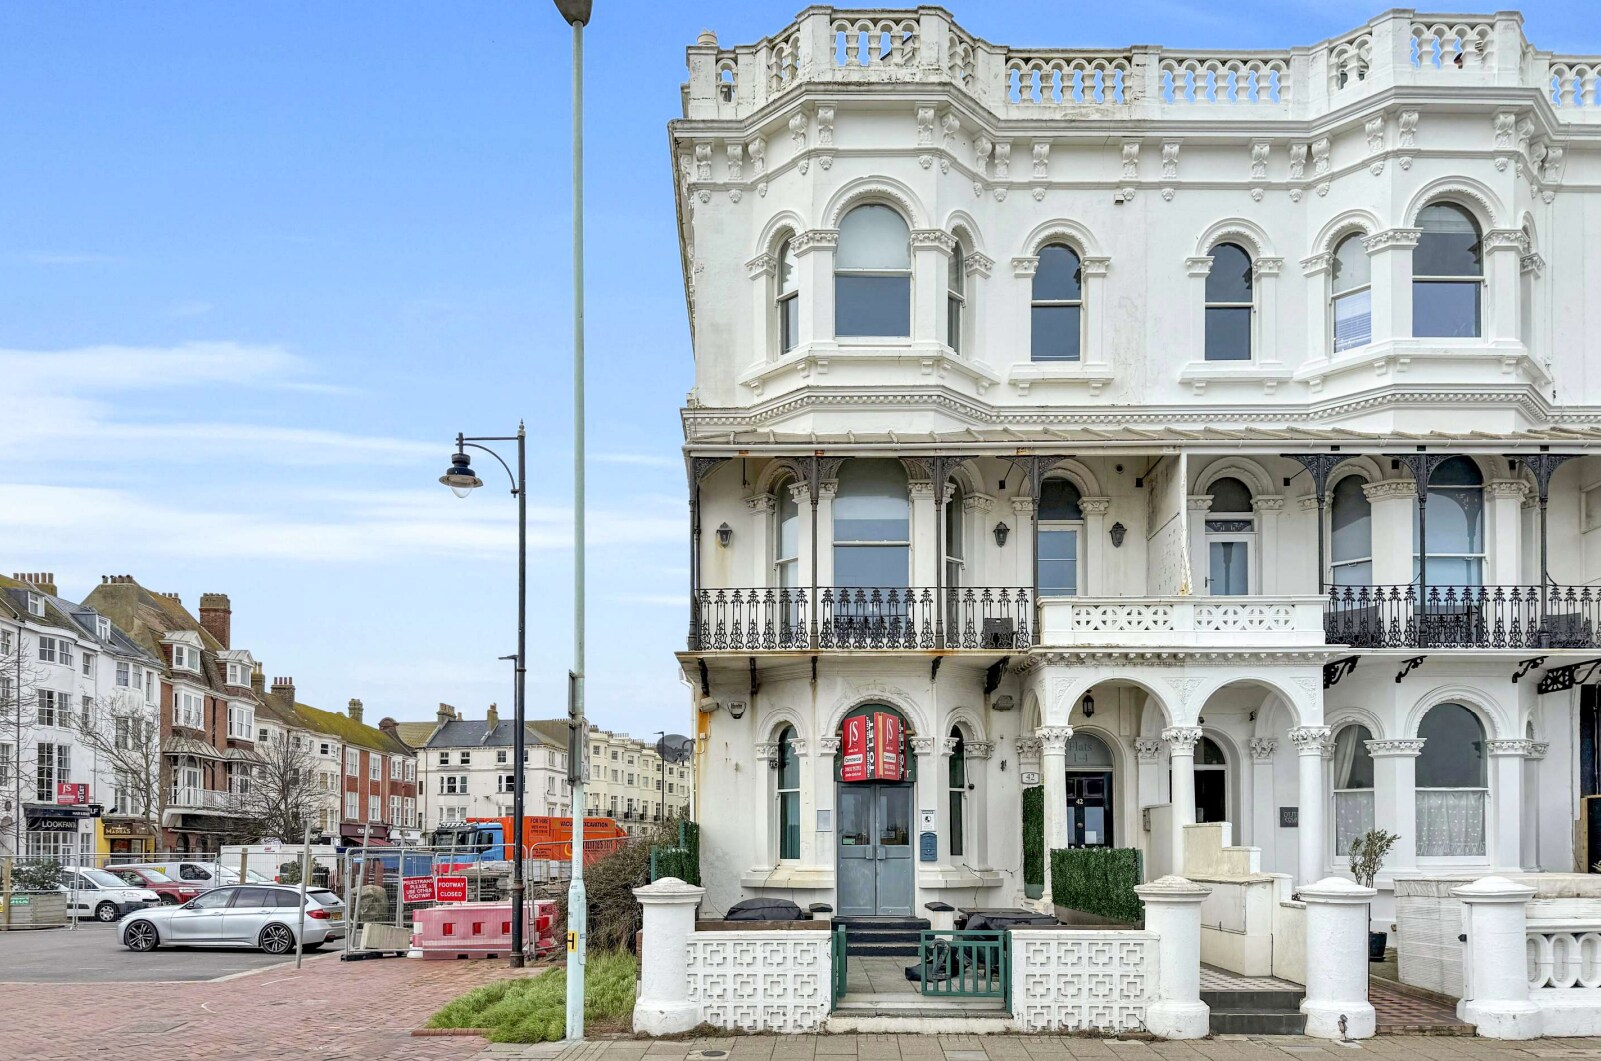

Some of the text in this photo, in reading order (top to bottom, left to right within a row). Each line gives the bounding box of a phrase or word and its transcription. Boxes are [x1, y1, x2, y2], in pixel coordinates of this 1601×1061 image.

[1069, 741, 1093, 752] Flats
[869, 751, 875, 773] TO
[1025, 773, 1035, 781] 42
[403, 878, 434, 886] PEDESTRIANS
